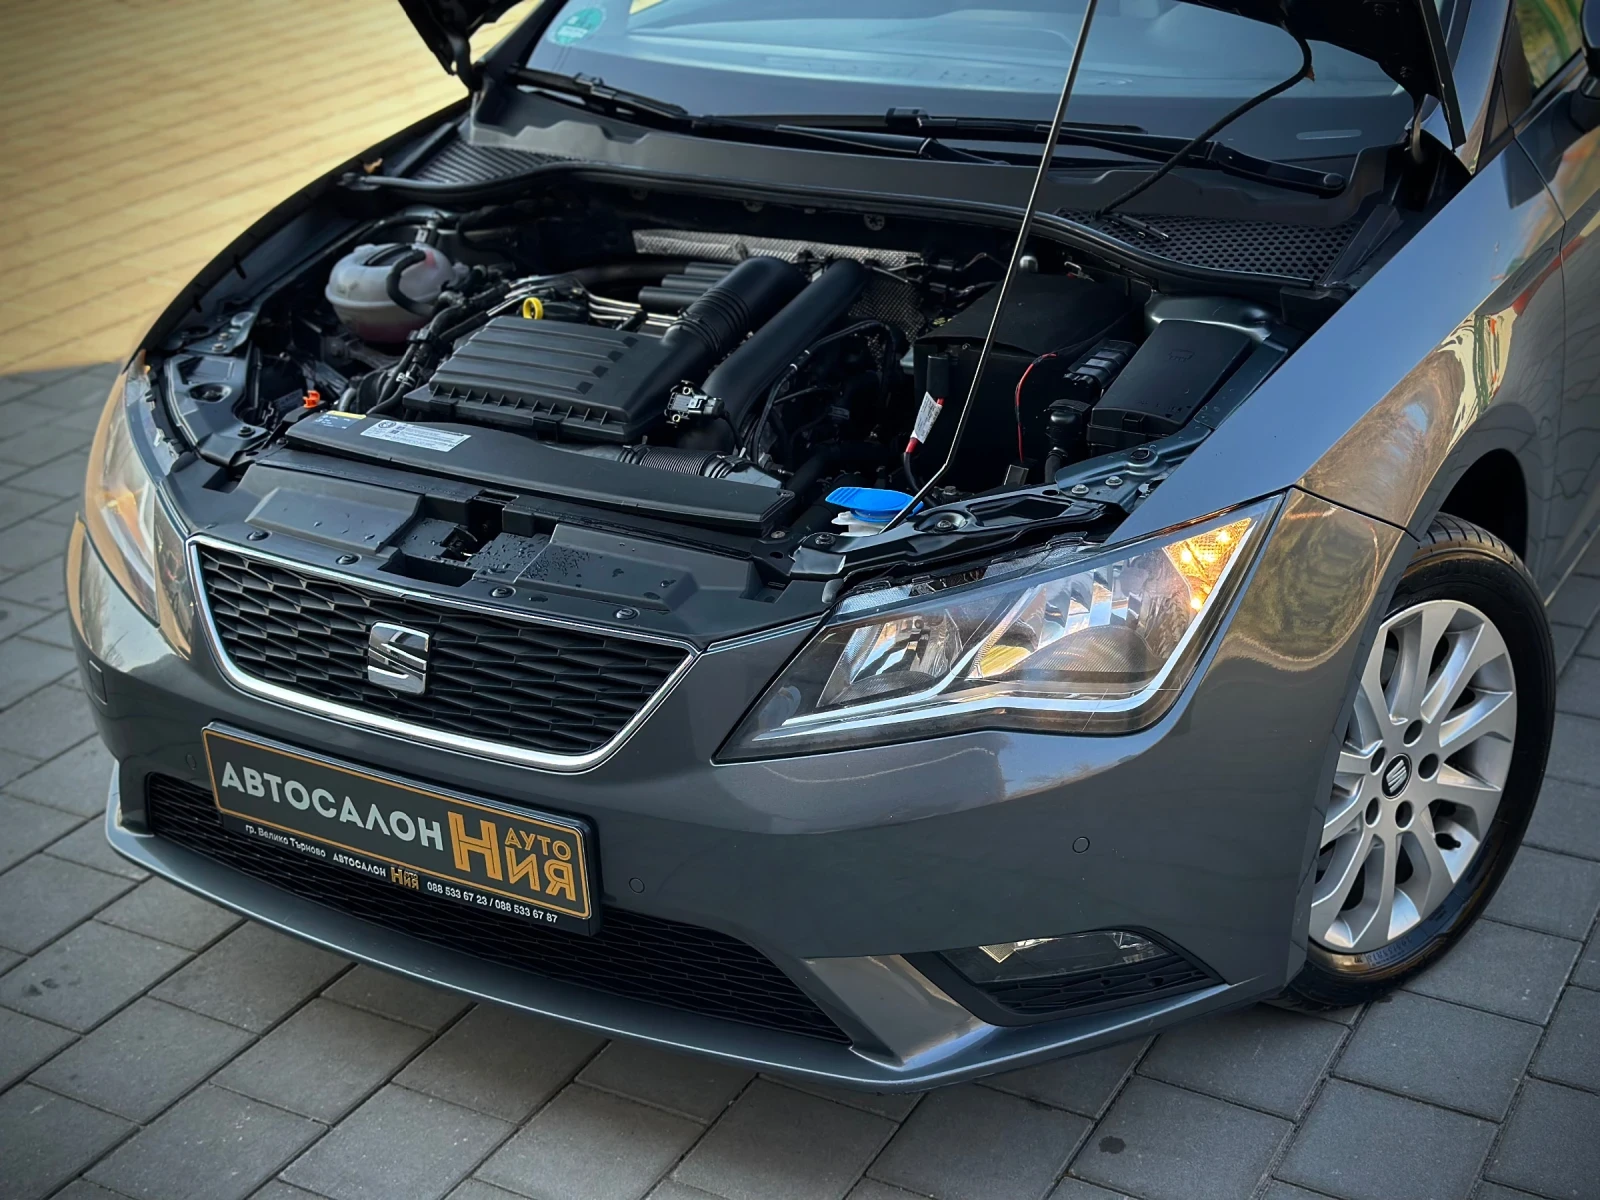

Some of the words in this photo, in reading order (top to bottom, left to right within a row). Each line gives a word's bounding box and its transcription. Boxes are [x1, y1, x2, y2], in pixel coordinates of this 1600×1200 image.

[221, 761, 444, 852] АВТОСАЛОН
[245, 824, 257, 835] гр.
[257, 827, 289, 845] Велико
[289, 837, 327, 858] Търново
[332, 852, 387, 878] АВТОСАЛОН
[504, 827, 573, 862] АУТО
[427, 881, 444, 894] 088
[445, 886, 462, 899] 533
[463, 891, 475, 902] 67
[476, 894, 488, 906] 23
[495, 899, 512, 912] 088
[513, 904, 531, 917] 533
[532, 909, 545, 921] 67
[546, 912, 558, 924] 87
